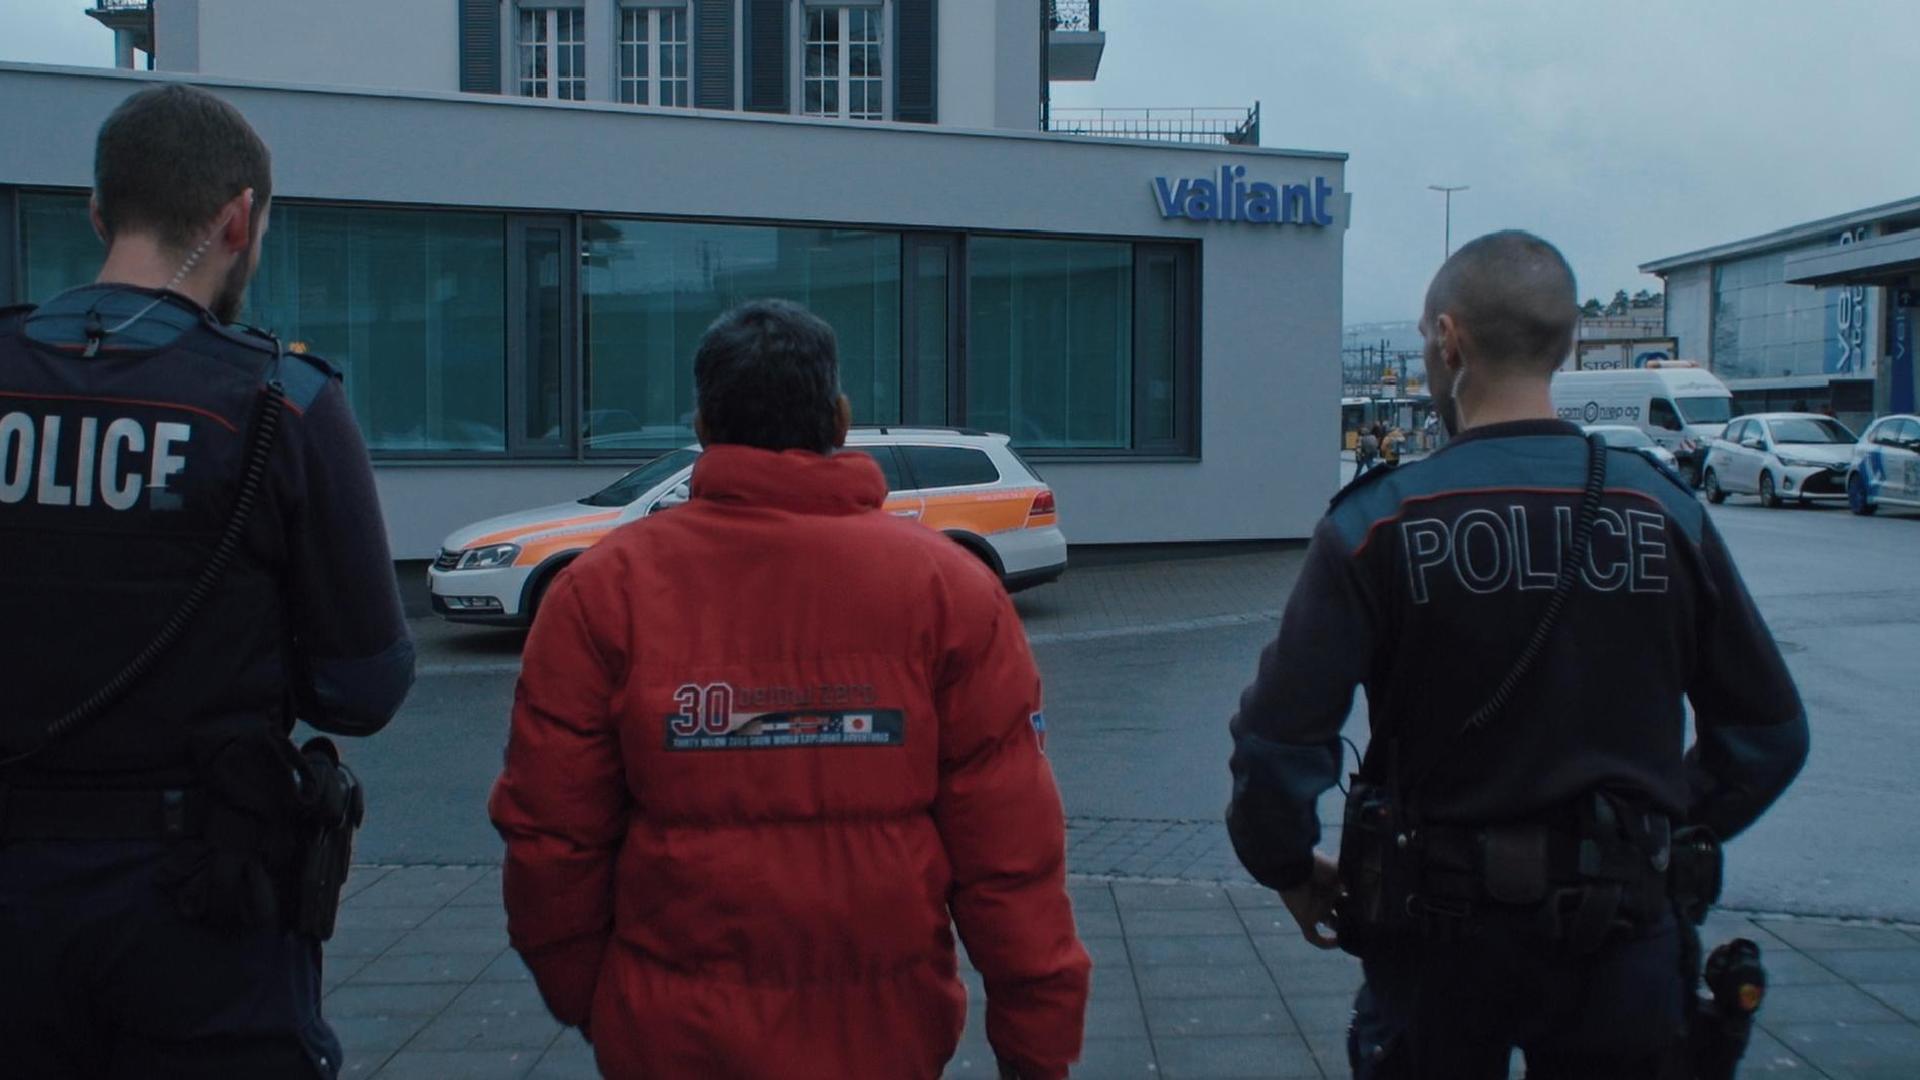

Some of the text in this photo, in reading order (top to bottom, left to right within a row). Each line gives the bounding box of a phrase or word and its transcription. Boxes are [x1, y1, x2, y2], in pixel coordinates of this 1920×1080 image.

[1152, 165, 1333, 225] valiant
[0, 411, 191, 511] OLICE
[1401, 505, 1668, 604] POLICE
[671, 682, 733, 736] 30
